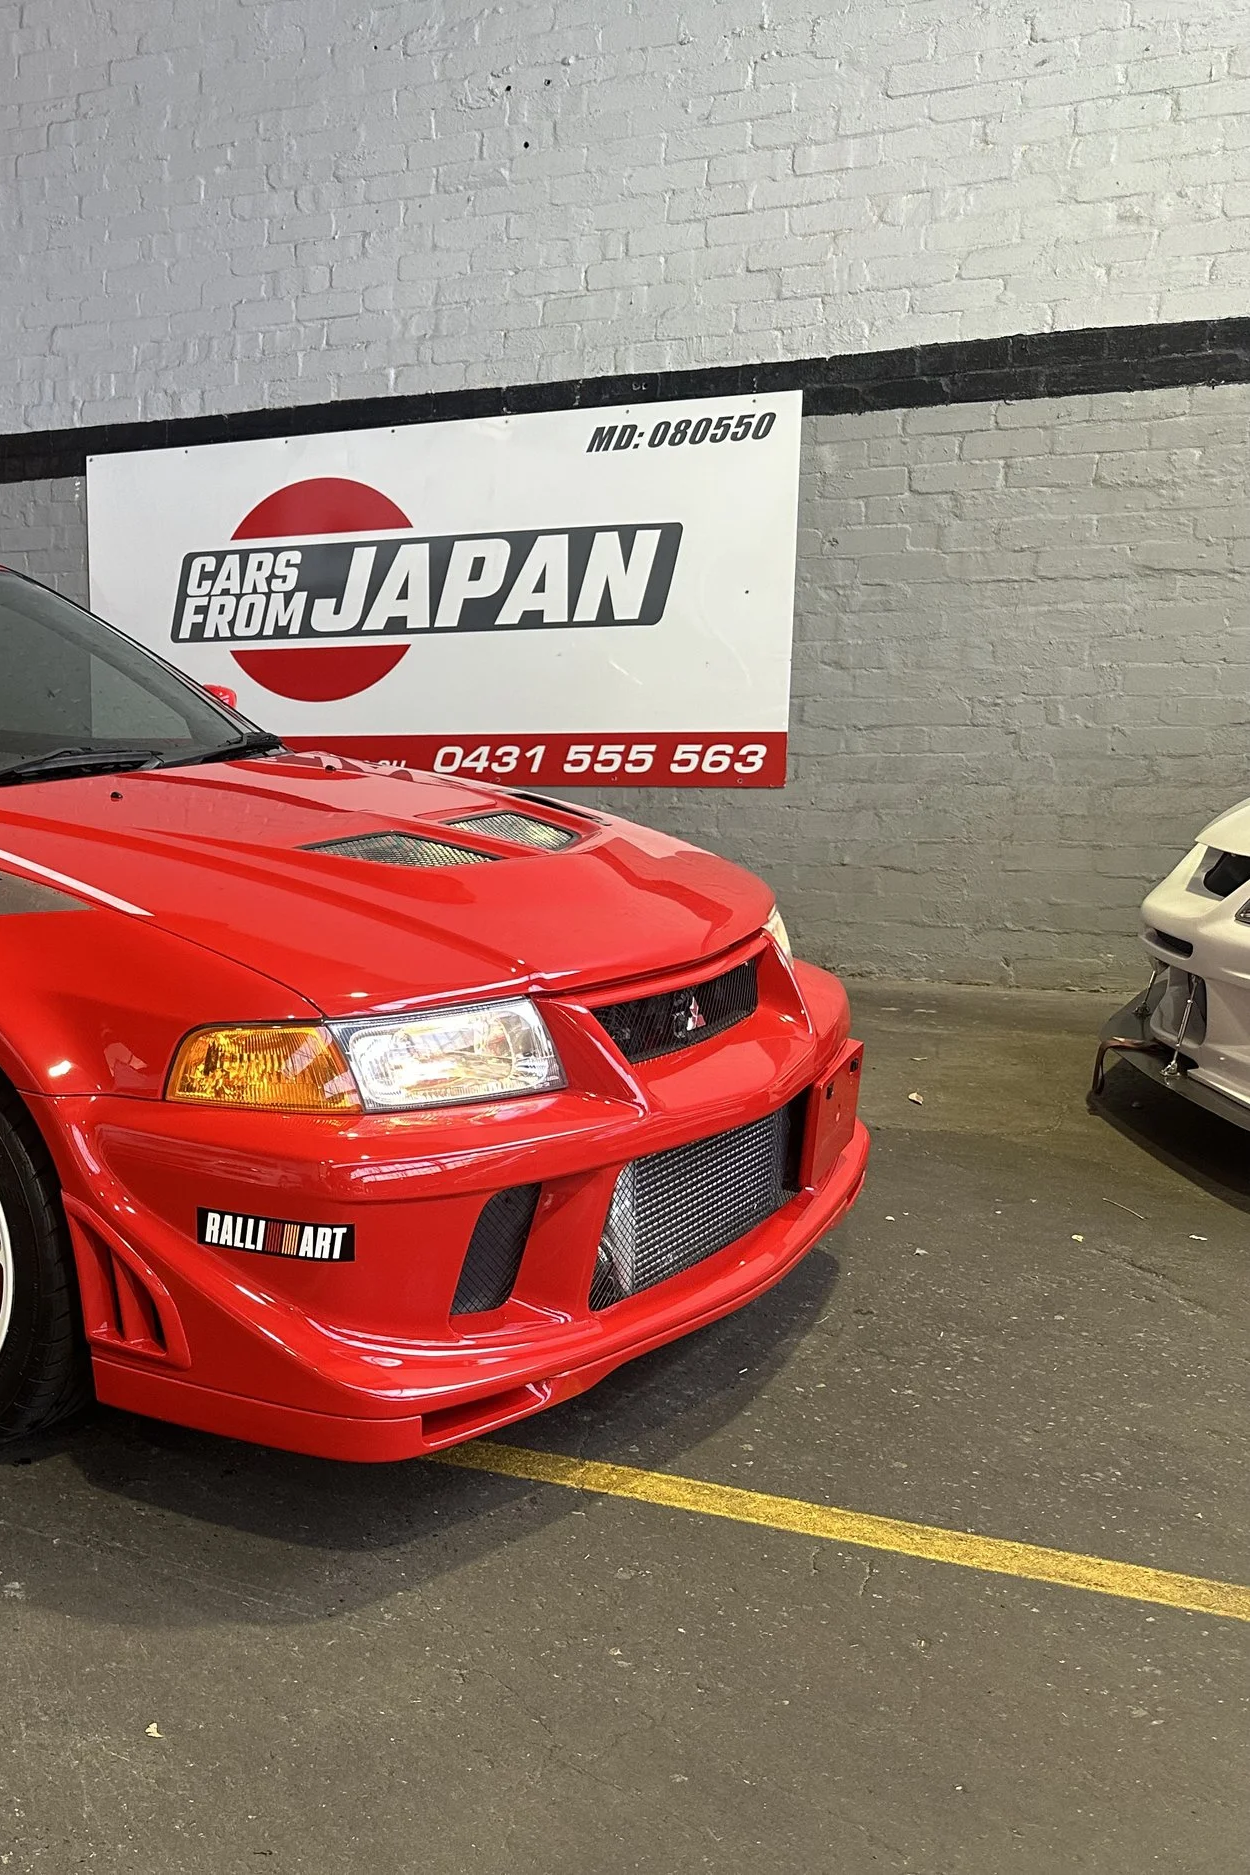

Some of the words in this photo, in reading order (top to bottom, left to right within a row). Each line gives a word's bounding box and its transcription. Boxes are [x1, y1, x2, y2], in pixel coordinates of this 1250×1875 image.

[586, 424, 644, 452] MD:
[648, 412, 777, 448] 080550
[186, 550, 303, 597] CARS
[310, 529, 664, 633] JAPAN
[179, 591, 308, 639] FROM
[433, 745, 546, 773] 0431
[563, 745, 657, 773] 555
[670, 744, 767, 774] 563
